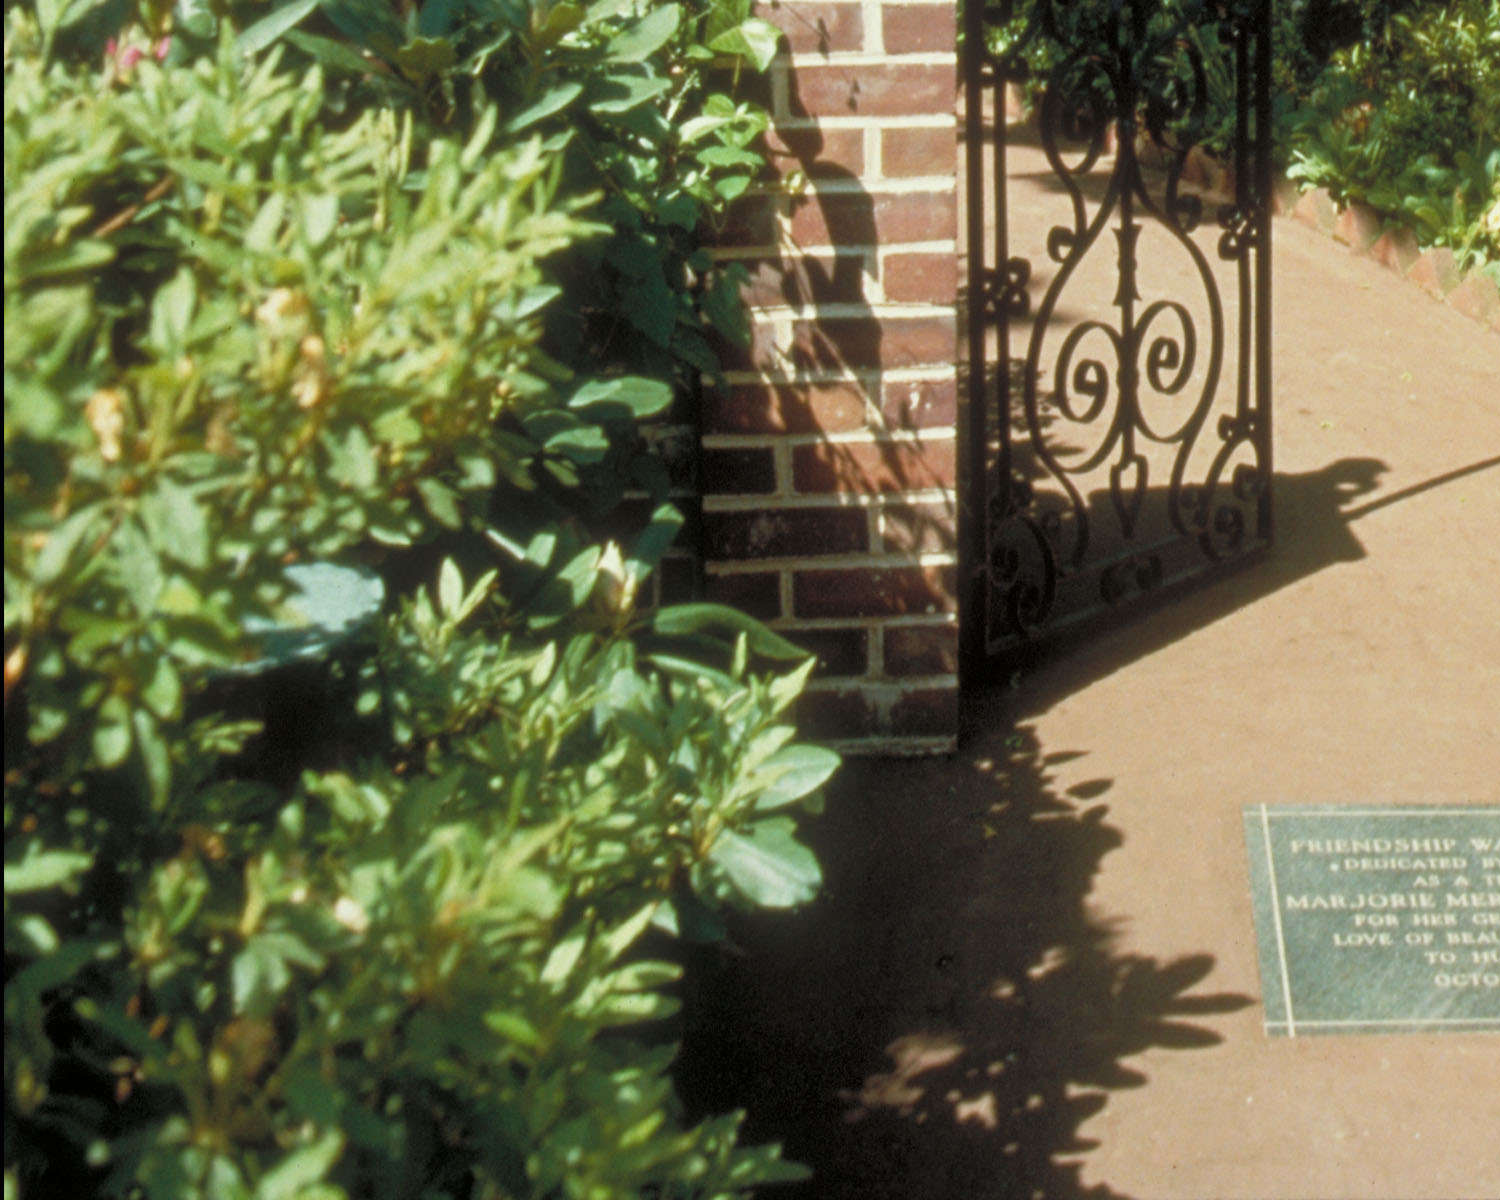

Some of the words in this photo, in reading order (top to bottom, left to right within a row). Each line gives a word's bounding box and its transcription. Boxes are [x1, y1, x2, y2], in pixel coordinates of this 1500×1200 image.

[1291, 837, 1456, 854] FRIENDSHIP
[1343, 858, 1468, 870] DEDICATED
[1412, 874, 1440, 887] AS
[1453, 874, 1471, 887] A
[1285, 893, 1437, 909] MARJORIE
[1354, 913, 1399, 926] FOR
[1412, 912, 1457, 926] HER
[1333, 933, 1394, 947] LOVE
[1404, 932, 1435, 945] OF
[1424, 951, 1457, 964] TO
